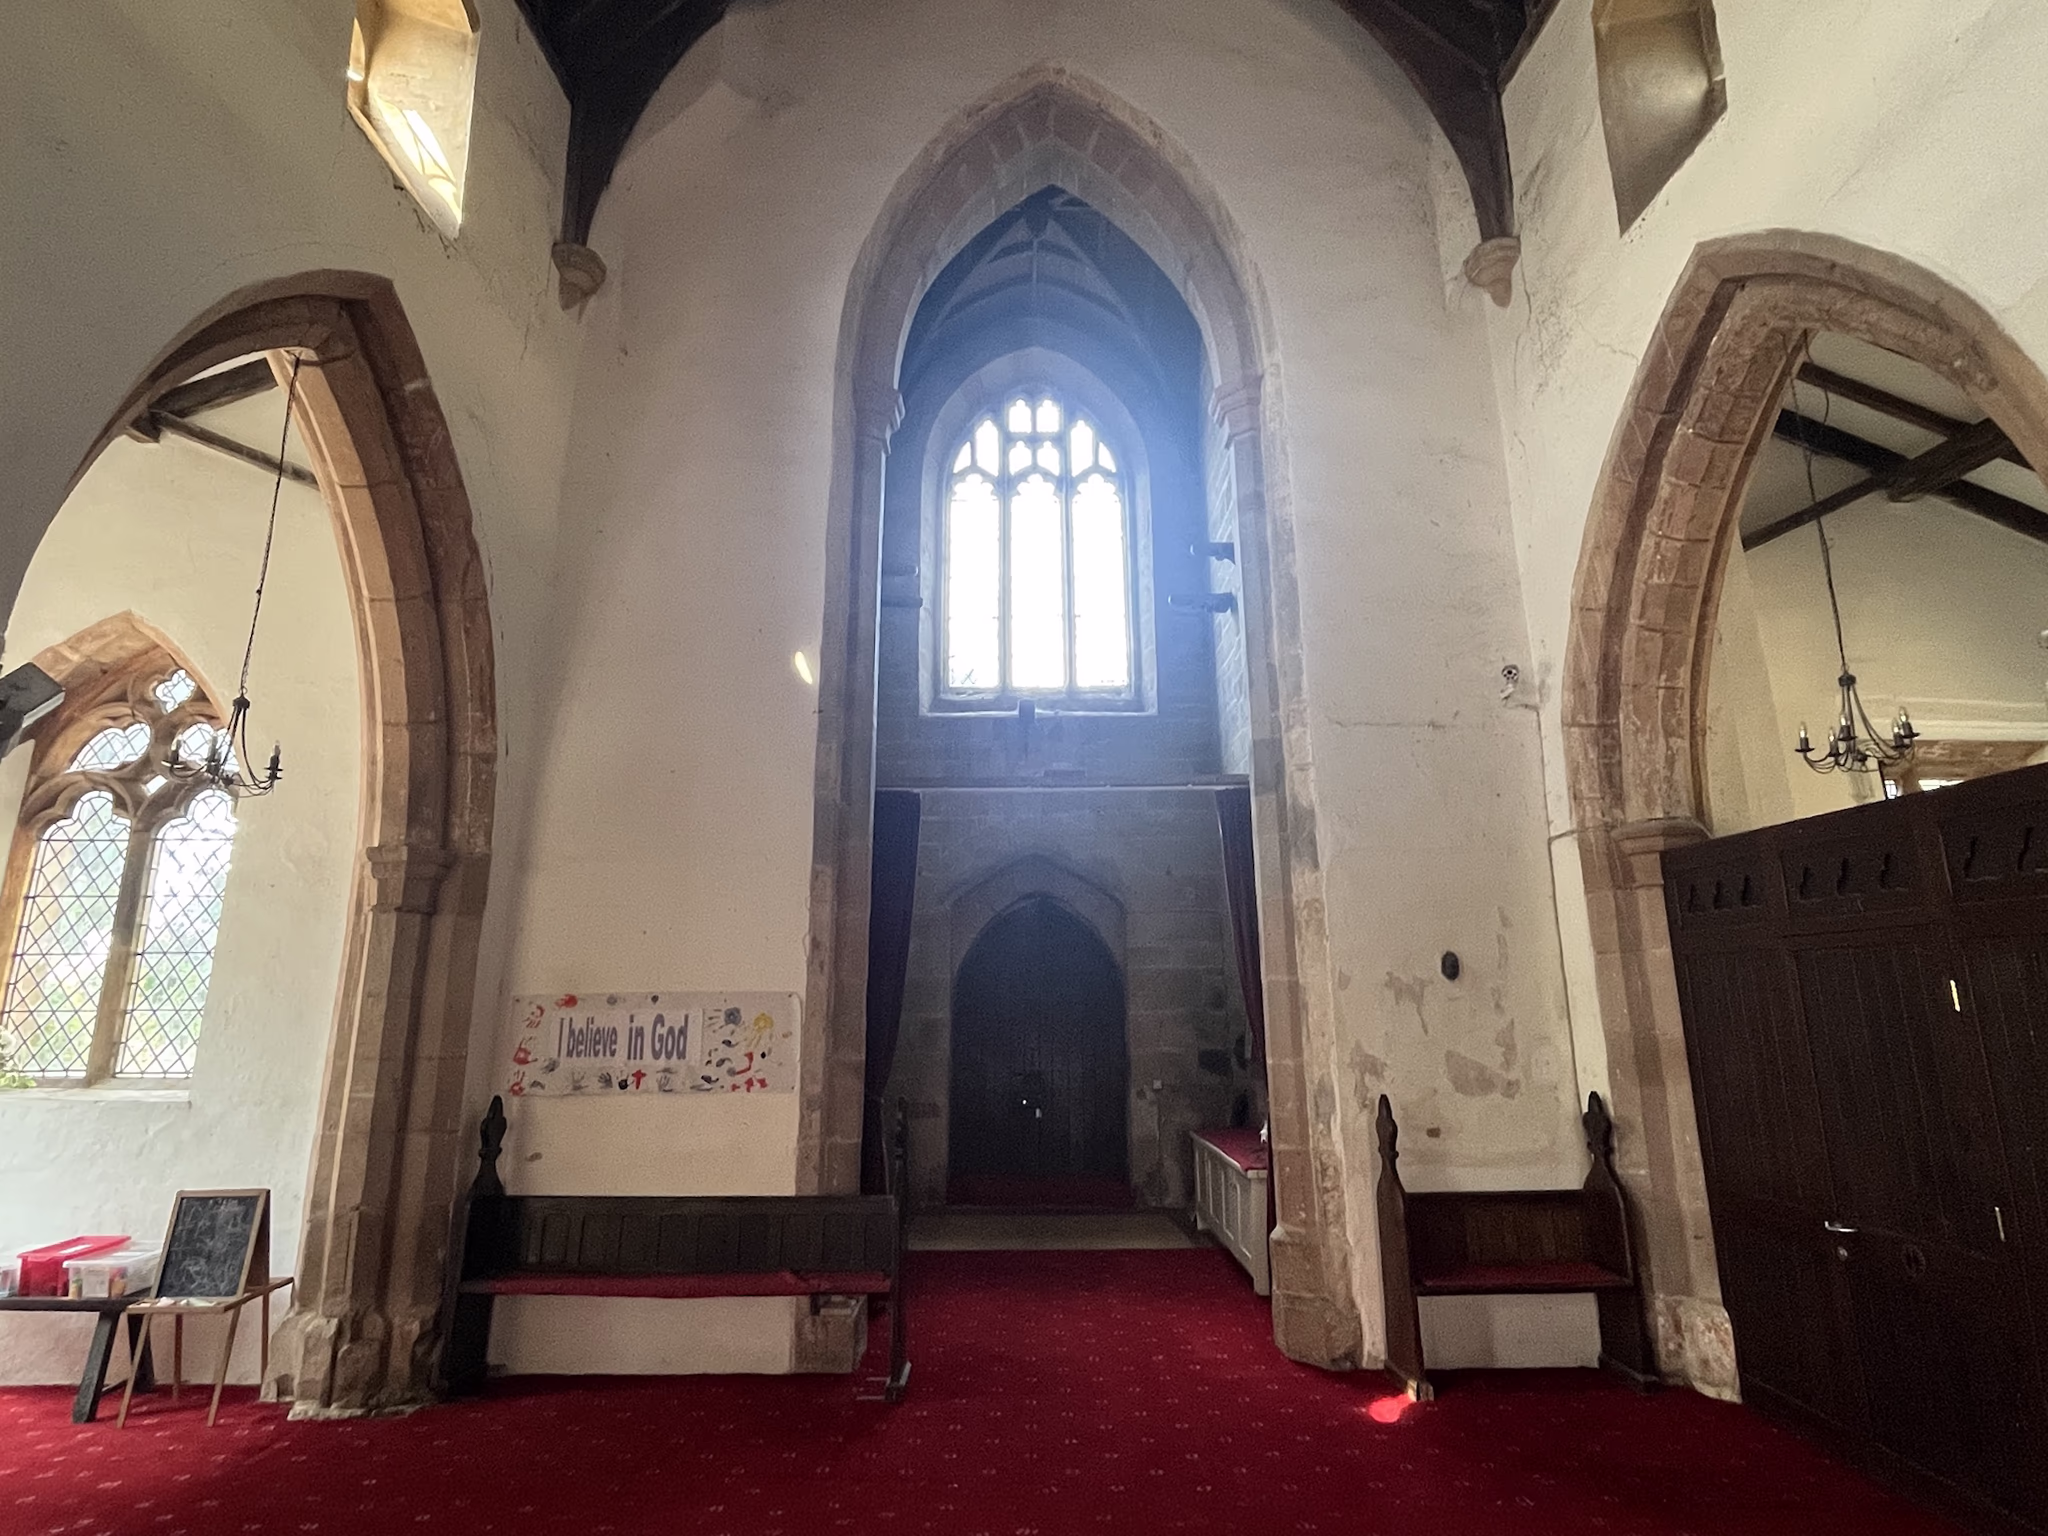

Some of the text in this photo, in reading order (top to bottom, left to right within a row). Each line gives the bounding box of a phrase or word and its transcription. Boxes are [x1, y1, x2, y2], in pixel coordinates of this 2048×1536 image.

[557, 1013, 689, 1061] I believe in God
